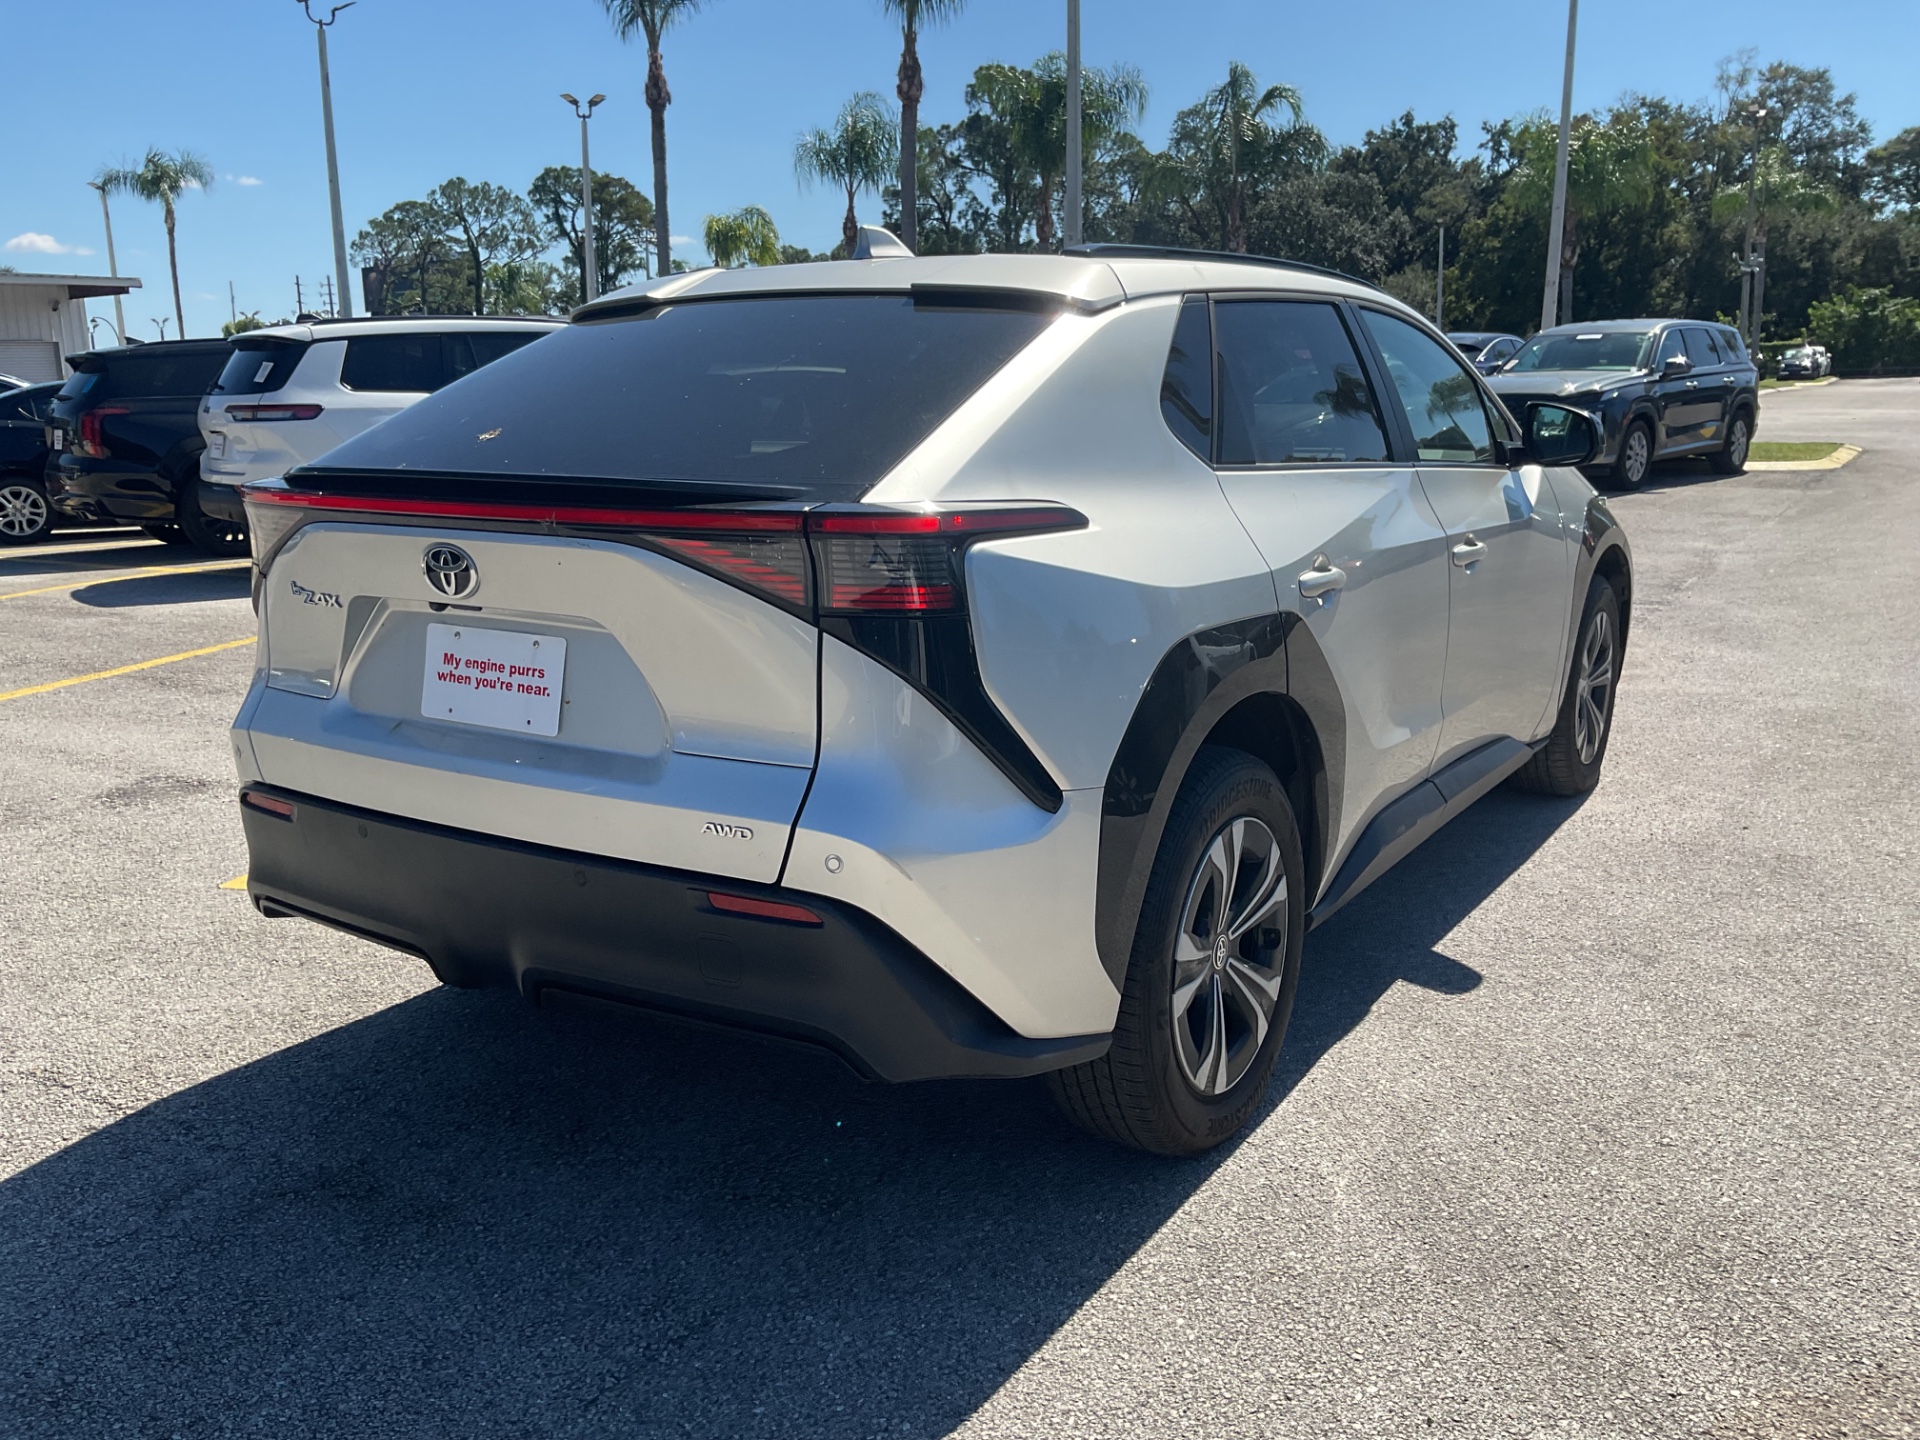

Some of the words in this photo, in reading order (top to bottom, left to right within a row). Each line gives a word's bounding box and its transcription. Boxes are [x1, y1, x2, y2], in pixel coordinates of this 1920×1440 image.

[443, 652, 462, 670] My
[464, 658, 506, 674] engine
[508, 664, 546, 679] purrs
[437, 670, 472, 686] when
[474, 676, 513, 692] you're
[516, 682, 551, 697] near.
[700, 821, 754, 841] AWD
